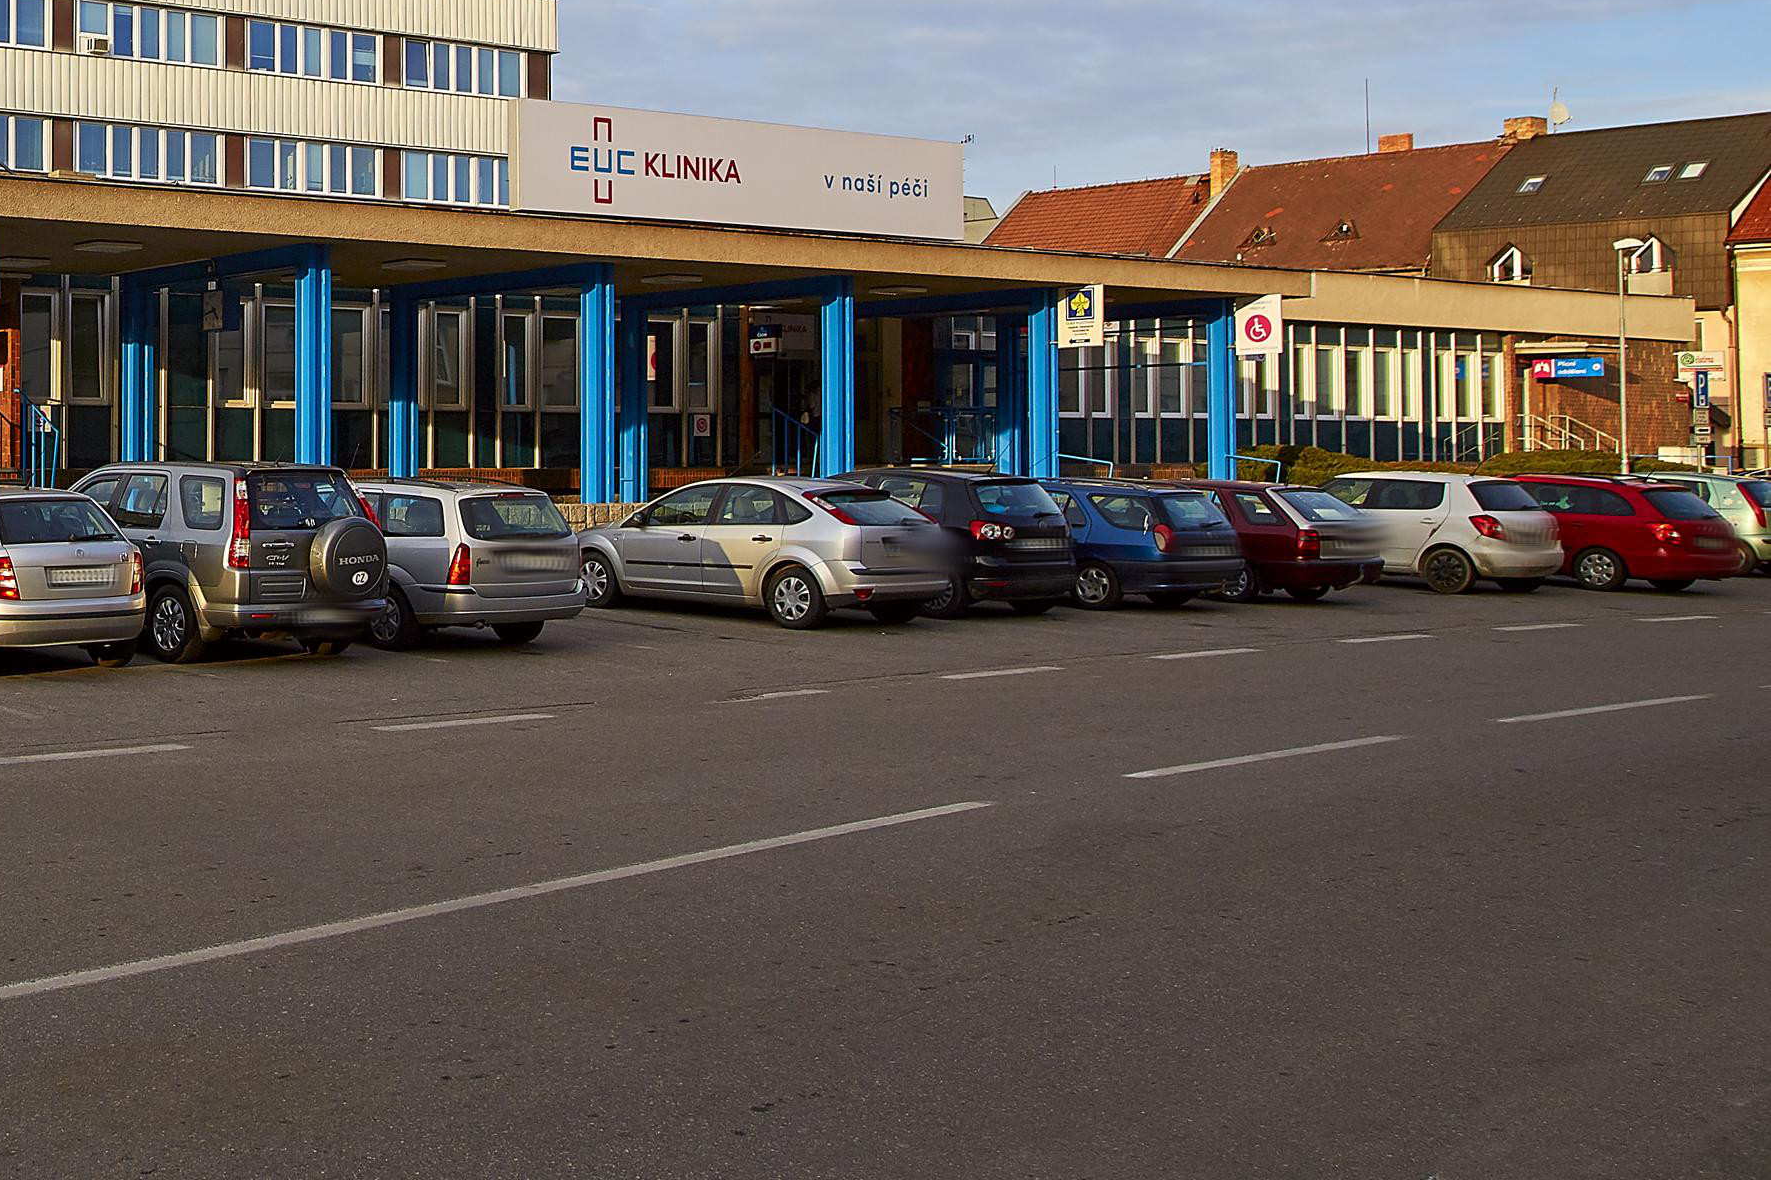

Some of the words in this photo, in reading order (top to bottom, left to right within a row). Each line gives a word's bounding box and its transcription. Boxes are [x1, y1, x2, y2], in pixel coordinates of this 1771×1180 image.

[570, 146, 635, 175] EUC
[644, 152, 742, 184] KLINIKA
[824, 174, 834, 189] v
[842, 173, 882, 194] naší
[889, 177, 928, 199] péči
[338, 553, 381, 567] HONDA
[355, 572, 366, 583] CZ
